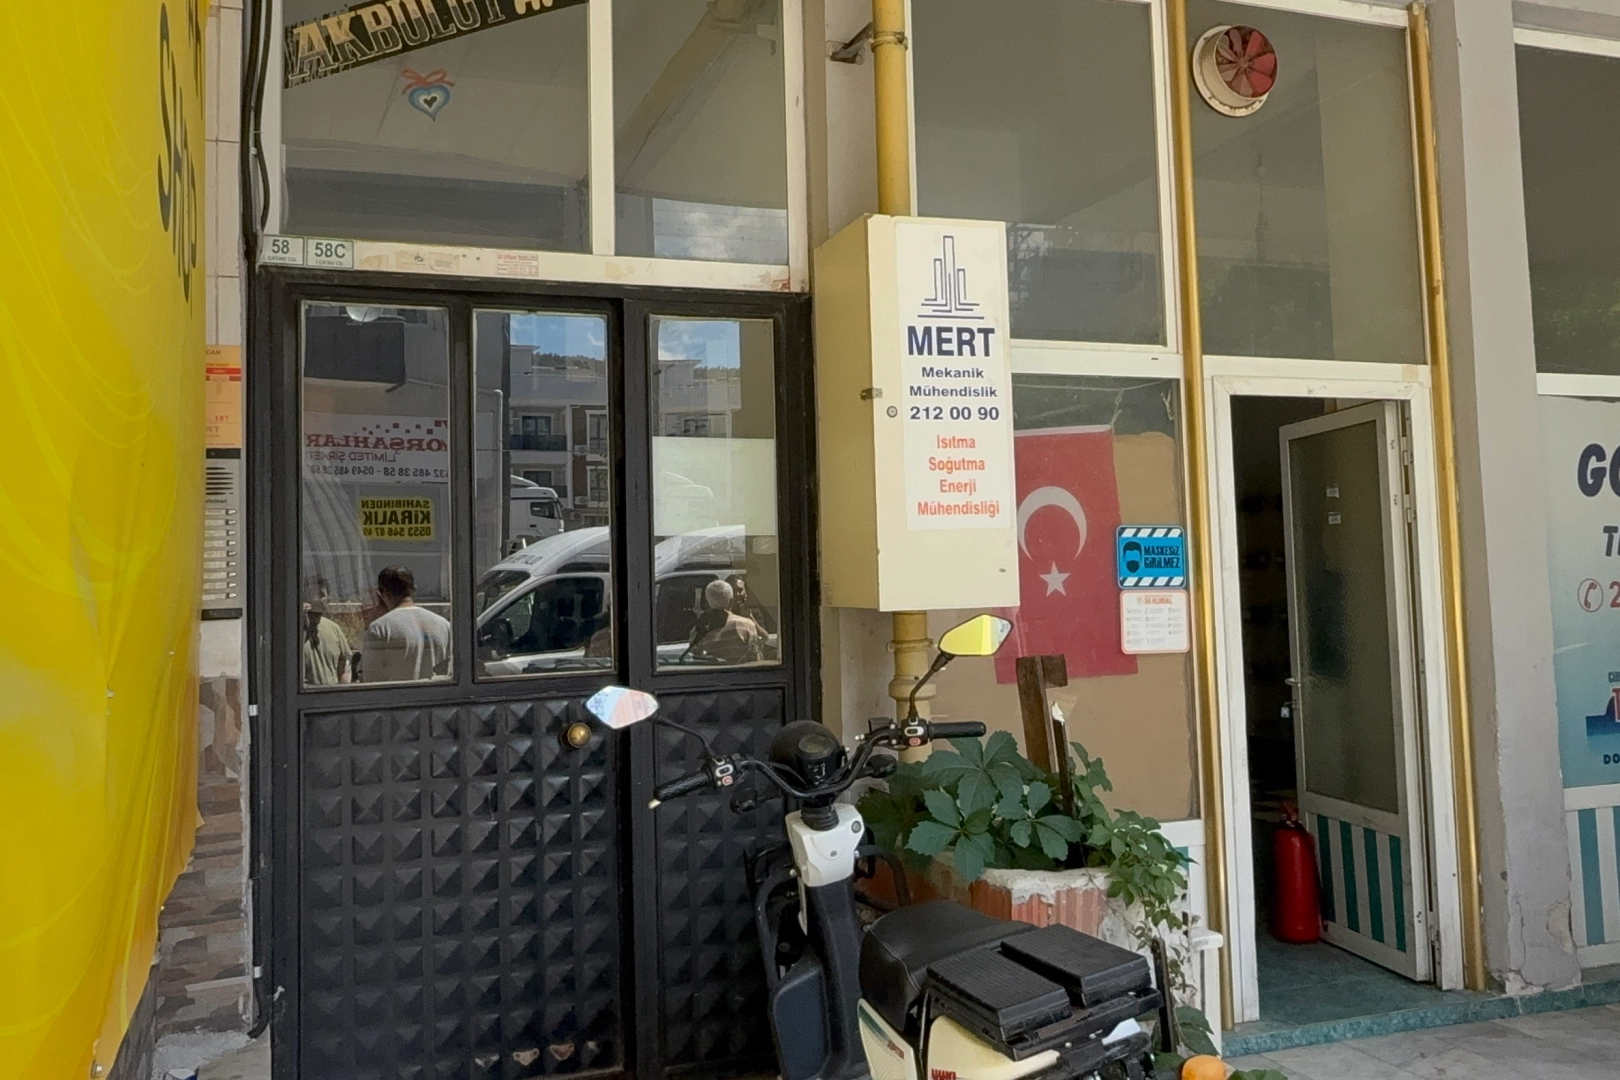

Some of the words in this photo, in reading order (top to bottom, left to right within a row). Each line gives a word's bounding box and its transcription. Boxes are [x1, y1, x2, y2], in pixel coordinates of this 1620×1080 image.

[272, 239, 289, 254] 58
[314, 242, 346, 258] 58C
[907, 325, 995, 357] MERT
[921, 366, 984, 378] Mekanik
[909, 385, 998, 397] Mühendislik
[909, 405, 944, 420] 212
[949, 406, 972, 420] 00
[977, 406, 1000, 420] 90
[936, 434, 976, 449] Isıtma
[928, 456, 986, 474] Soğutma
[939, 479, 977, 496] Enerji
[917, 500, 1000, 518] Mühendisliği
